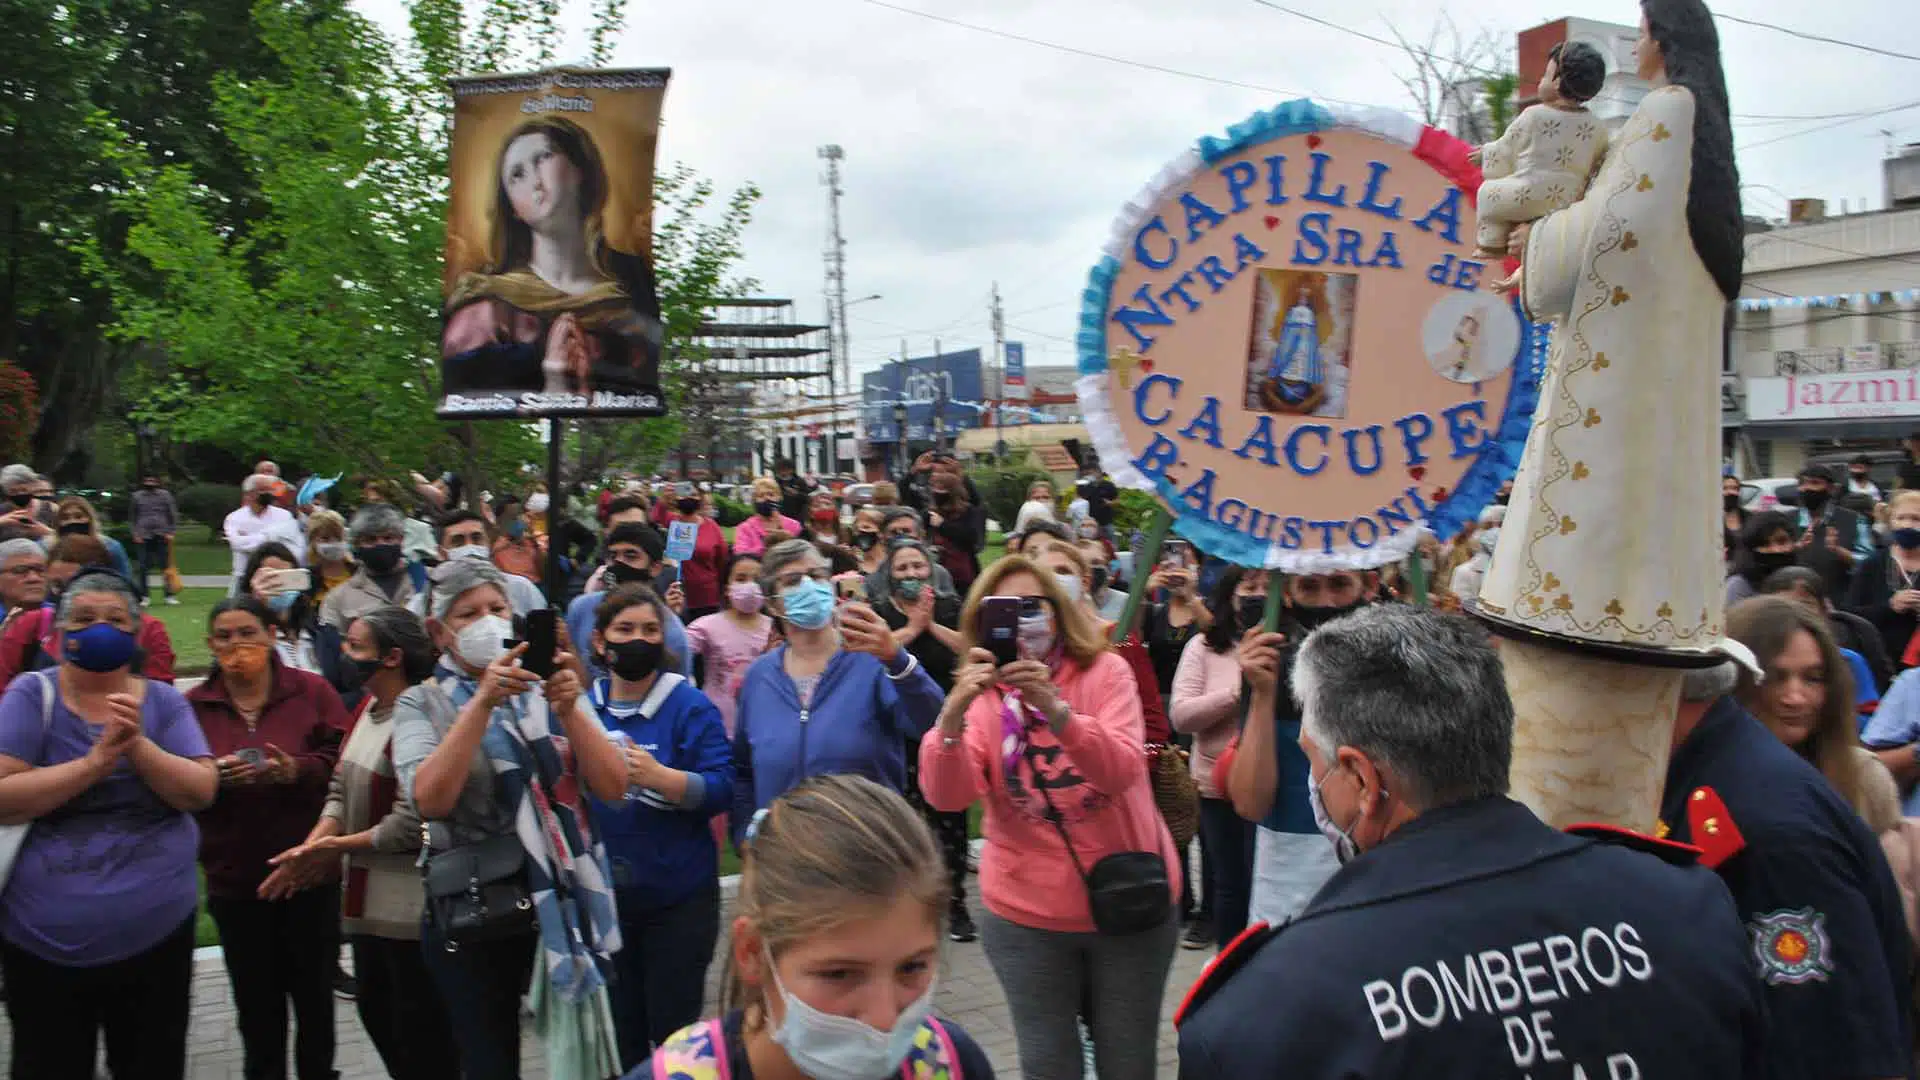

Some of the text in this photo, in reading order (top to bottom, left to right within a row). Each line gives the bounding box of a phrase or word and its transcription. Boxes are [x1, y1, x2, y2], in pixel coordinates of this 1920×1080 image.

[1133, 151, 1465, 270] CAPILLA
[1112, 232, 1268, 355] NTRA
[1179, 469, 1437, 555] AGUSTONI
[1362, 921, 1653, 1041] BOMBEROS
[1503, 1010, 1564, 1067] DE
